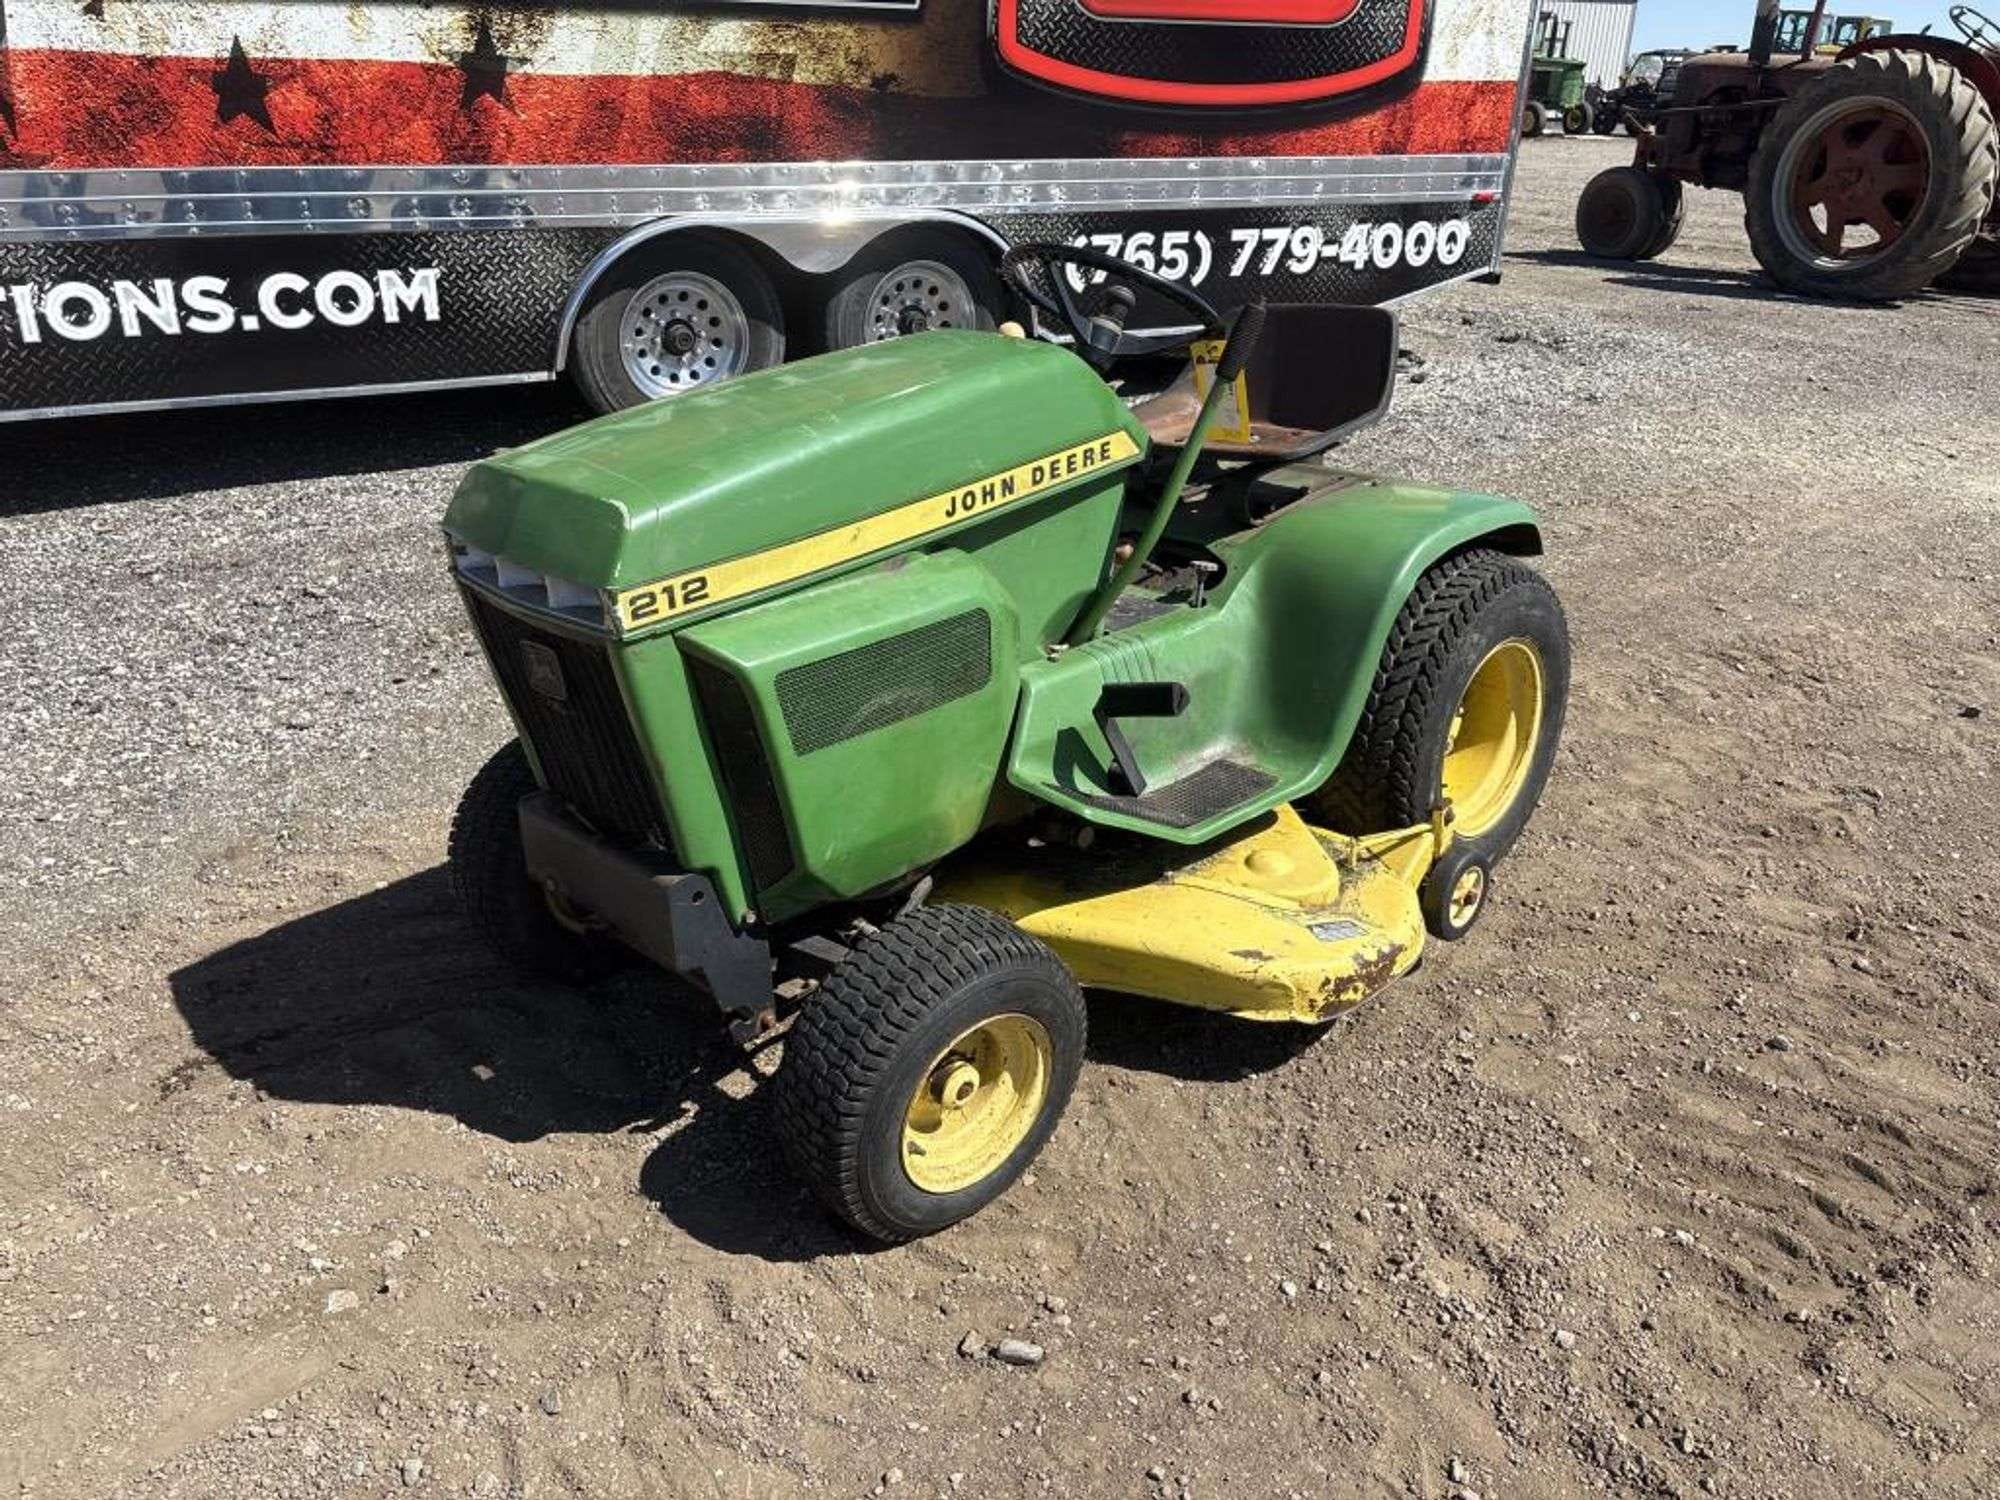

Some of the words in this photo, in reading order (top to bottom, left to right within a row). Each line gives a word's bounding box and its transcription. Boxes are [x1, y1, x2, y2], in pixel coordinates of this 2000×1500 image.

[1229, 218, 1471, 277] 779-4000
[0, 268, 441, 344] IONS.COM
[945, 475, 1015, 518] JOHN
[1031, 441, 1111, 487] DEERE
[629, 576, 709, 622] 212
